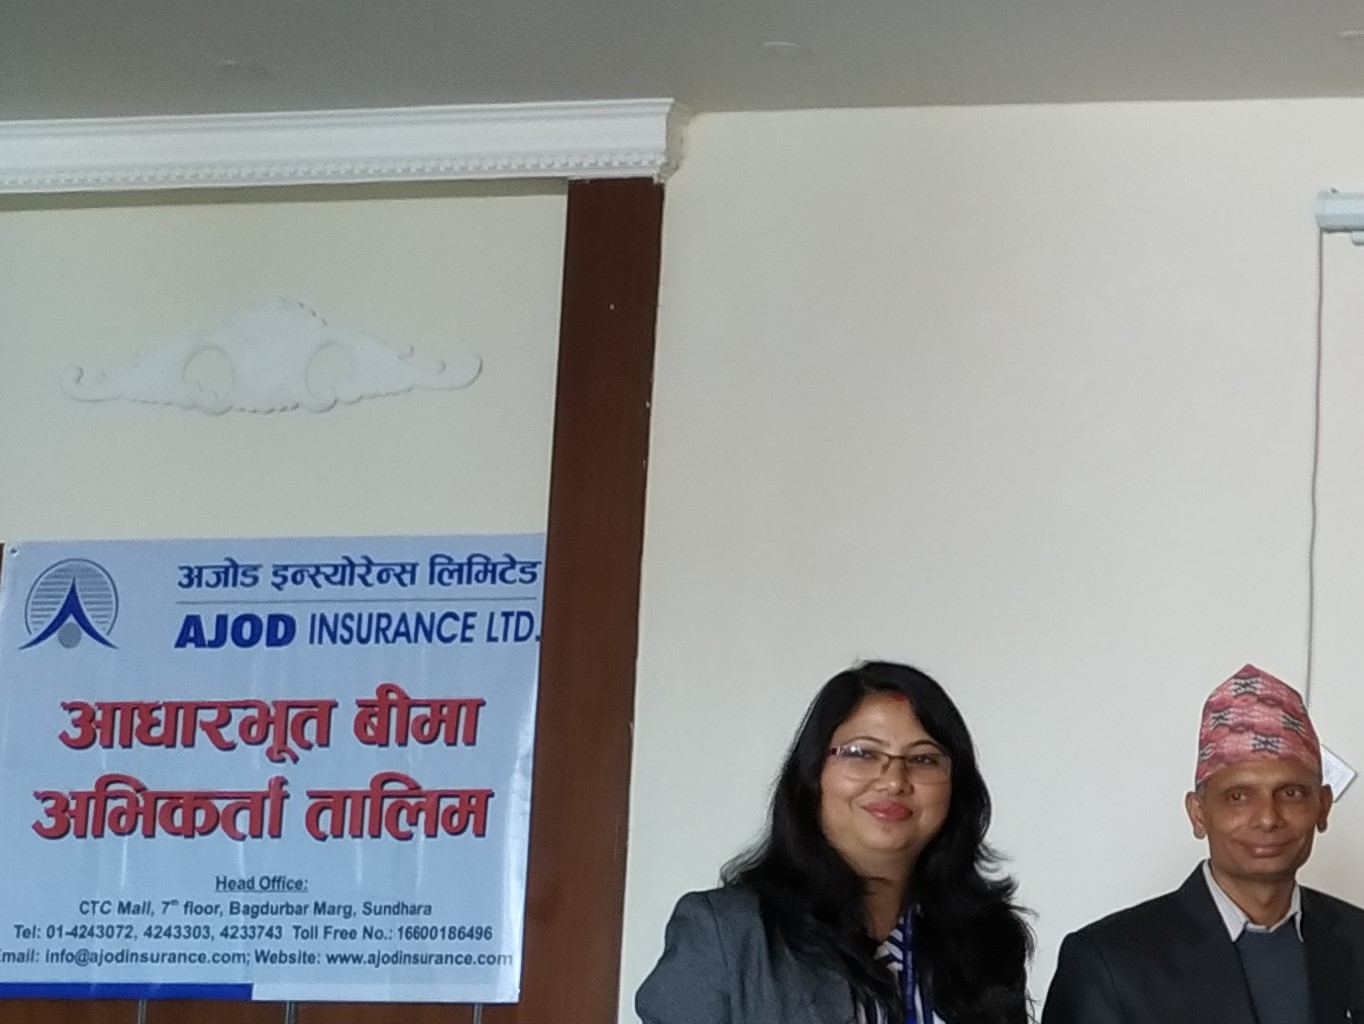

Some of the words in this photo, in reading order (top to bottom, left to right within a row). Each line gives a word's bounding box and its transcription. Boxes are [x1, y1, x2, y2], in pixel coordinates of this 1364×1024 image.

[177, 557, 262, 589] अजोड
[271, 556, 419, 591] इन्स्योरेन्स
[428, 554, 542, 588] लिमिटेड
[174, 613, 296, 649] AJOD
[309, 611, 477, 645] INSURANCE
[485, 610, 541, 643] LTD.
[58, 699, 338, 763] आधारभूत
[354, 682, 486, 748] बीमा
[32, 774, 290, 841] अभिकर्ता
[306, 771, 494, 841] तालिम
[214, 875, 255, 892] Head
[258, 875, 309, 893] Office:
[79, 901, 112, 916] CTC
[117, 900, 155, 917] Mall,
[183, 901, 223, 918] floor,
[229, 901, 309, 919] Bagdurbar
[313, 902, 357, 919] Marg,
[361, 901, 432, 917] Sundhara
[14, 924, 41, 940] Tel:
[46, 924, 138, 942] 01-4243072,
[143, 924, 215, 942] 4243303,
[219, 924, 283, 941] 4233743
[293, 925, 318, 940] Toll
[323, 925, 357, 940] Free
[362, 926, 392, 941] No.:
[397, 926, 493, 941] 16600186496
[0, 948, 40, 963] mail:
[45, 948, 251, 967] info@ajodinsurance.com;
[254, 949, 321, 965] Website:
[325, 950, 513, 968] www.ajodinsurance.com
